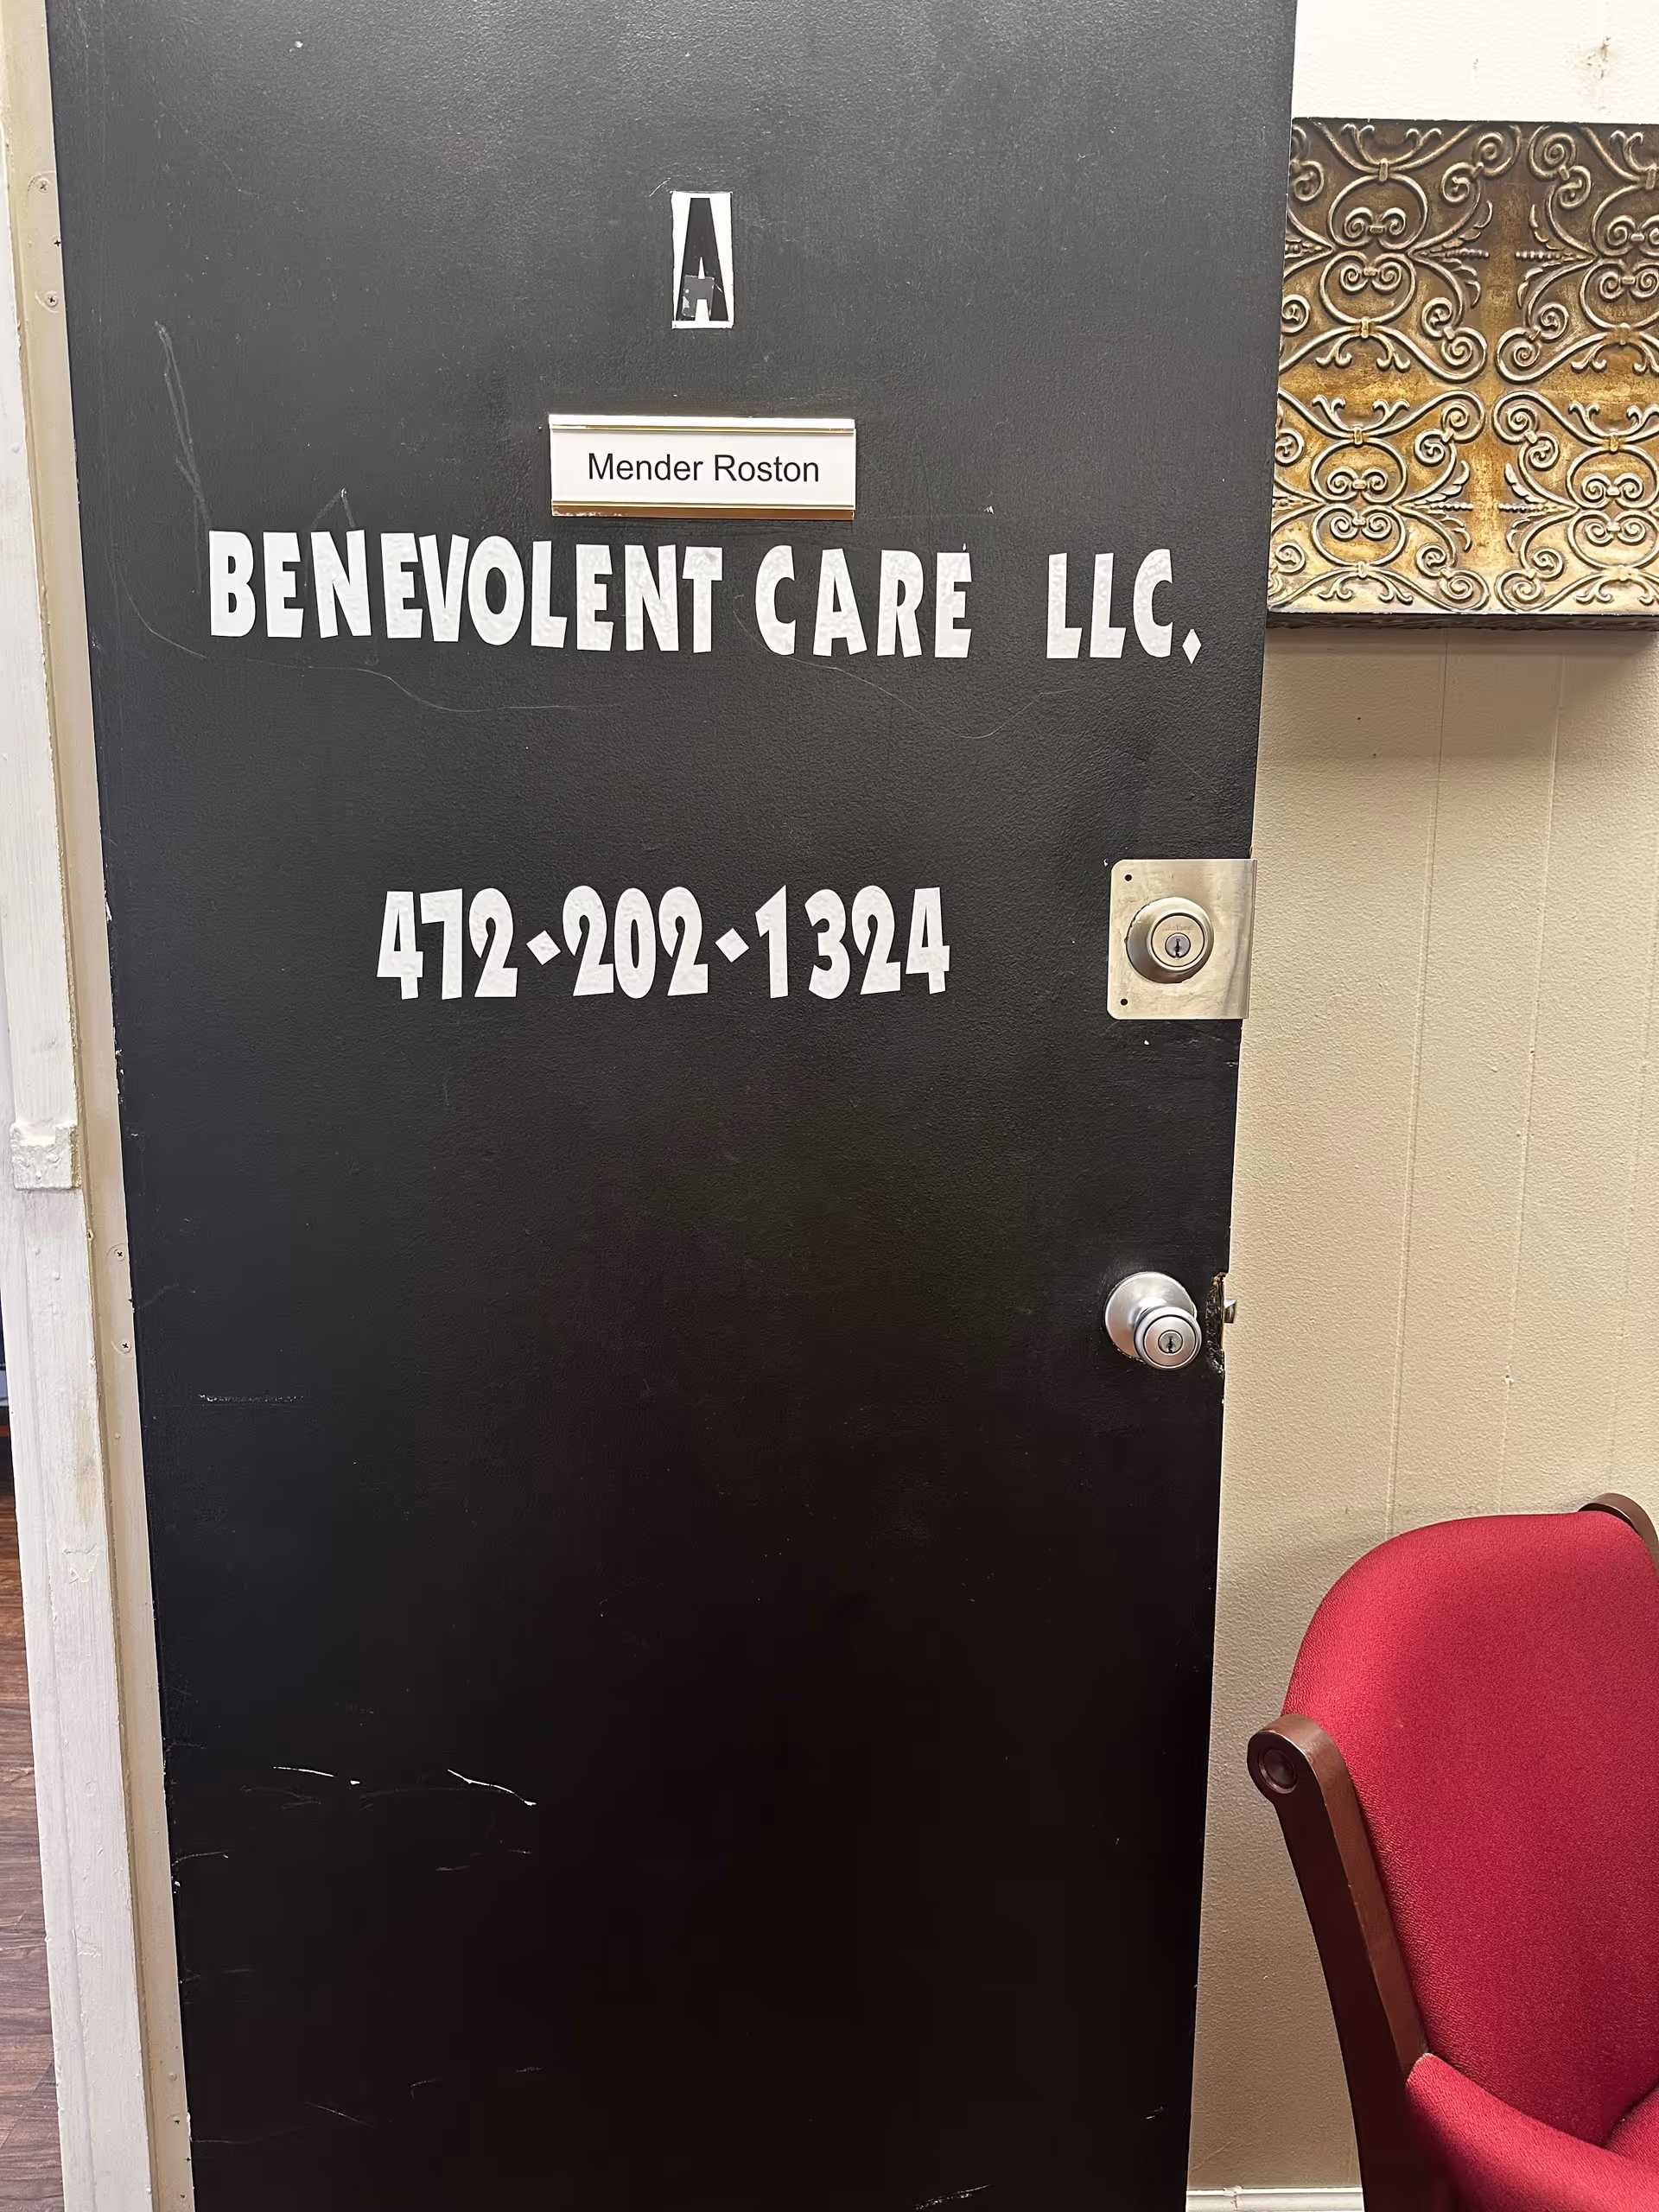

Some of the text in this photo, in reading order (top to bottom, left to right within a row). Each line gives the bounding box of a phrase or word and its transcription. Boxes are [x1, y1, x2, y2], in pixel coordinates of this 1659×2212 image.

[675, 197, 729, 321] A
[588, 453, 820, 483] Mender Roston
[208, 529, 1202, 664] BENEVOLENT CARE LLC.
